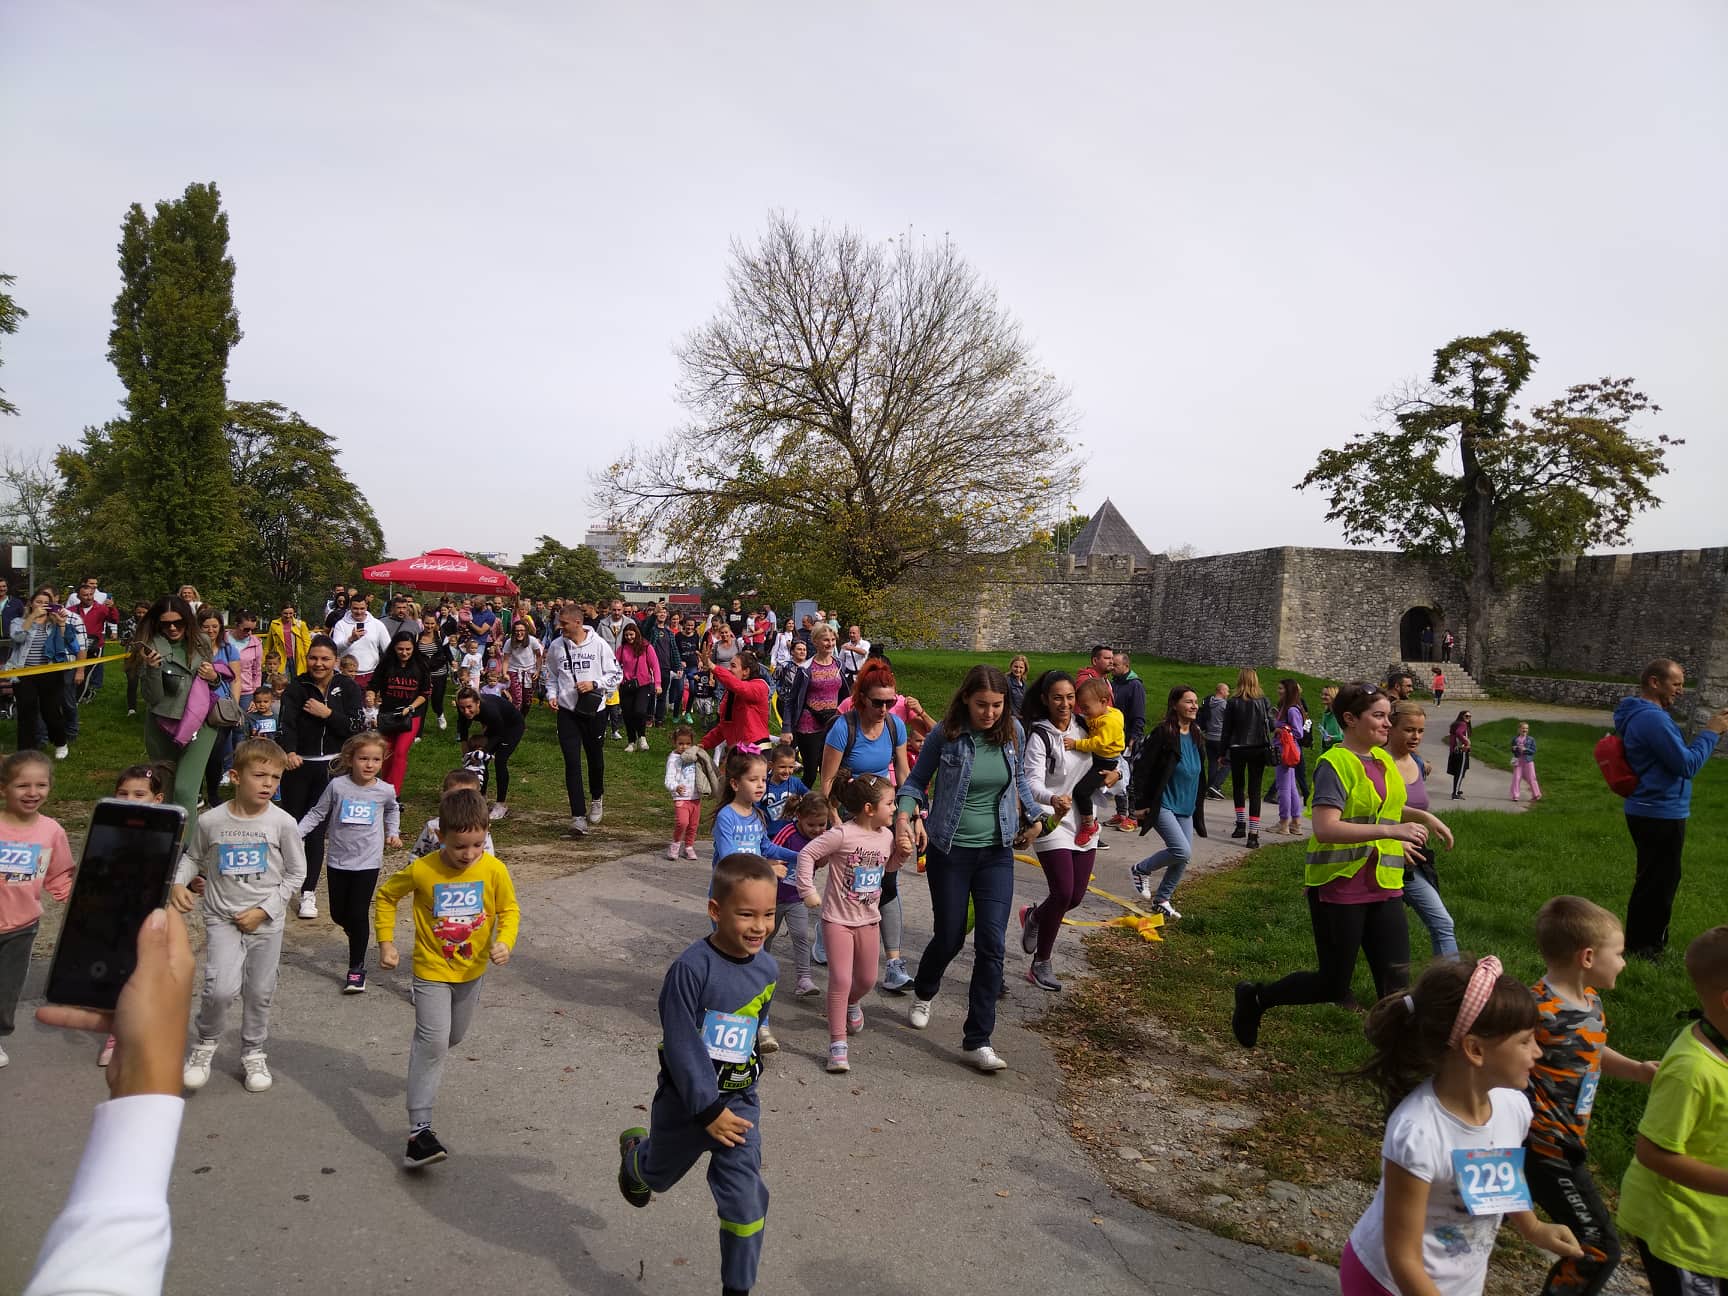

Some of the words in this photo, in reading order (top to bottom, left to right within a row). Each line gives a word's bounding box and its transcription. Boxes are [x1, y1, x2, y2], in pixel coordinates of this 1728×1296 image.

[348, 805, 371, 818] 195
[0, 848, 32, 865] 273
[225, 850, 260, 866] 133
[859, 873, 881, 886] 190
[440, 889, 478, 907] 226
[714, 1023, 748, 1049] 161
[1463, 1161, 1516, 1194] 229
